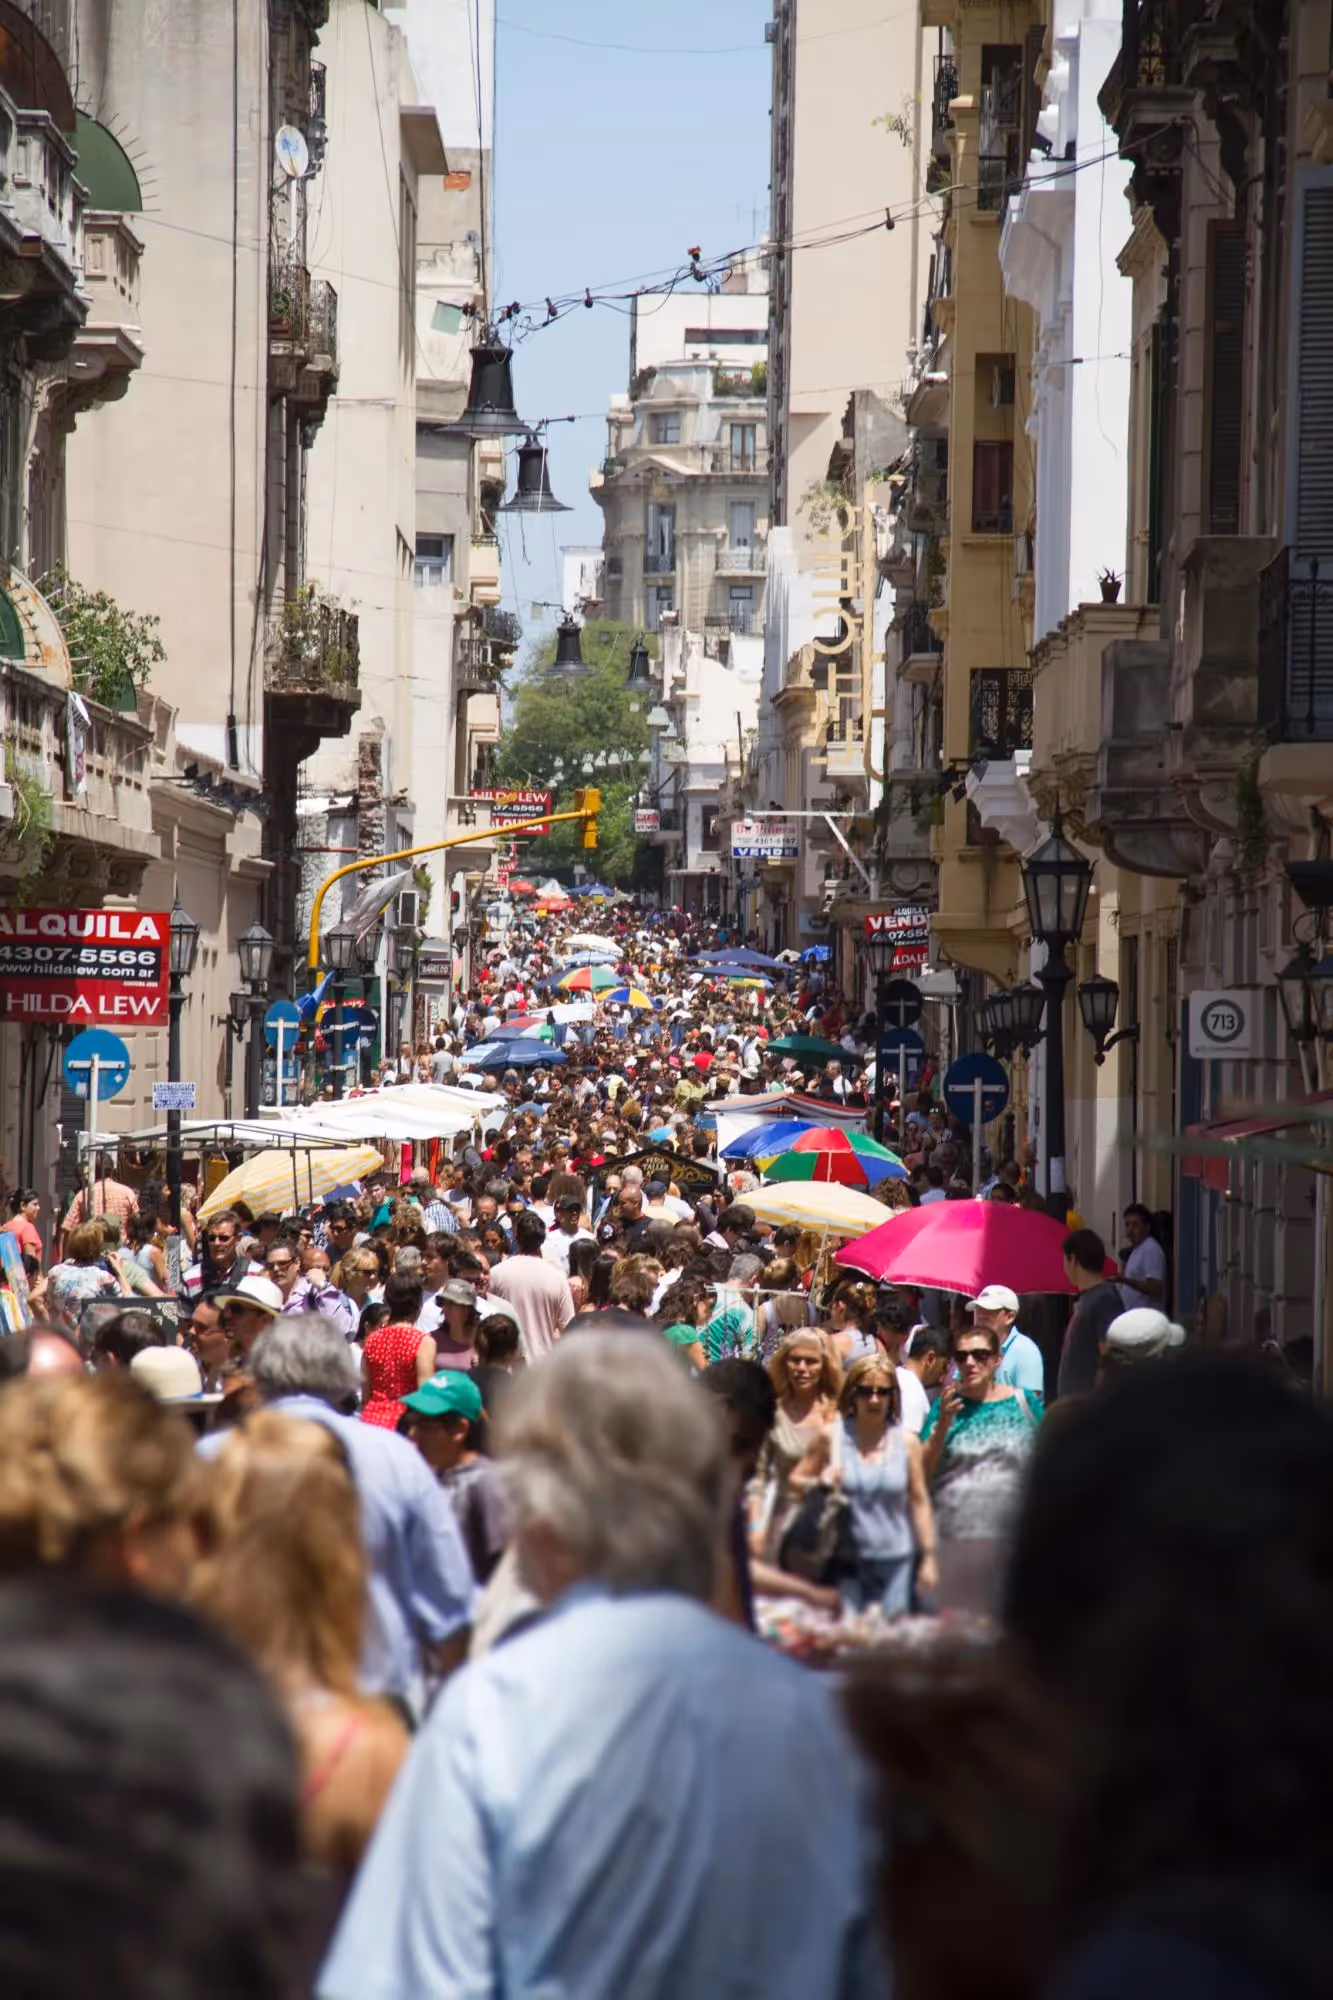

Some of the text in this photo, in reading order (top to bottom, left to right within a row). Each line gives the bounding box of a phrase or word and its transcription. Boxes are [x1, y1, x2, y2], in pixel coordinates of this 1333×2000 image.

[474, 792, 548, 802] HILD LEW
[0, 913, 160, 940] ALQUILA
[868, 914, 931, 930] VEND
[0, 945, 157, 966] 4307-5566
[6, 992, 161, 1015] HILDA LEW
[1211, 1014, 1235, 1030] 713
